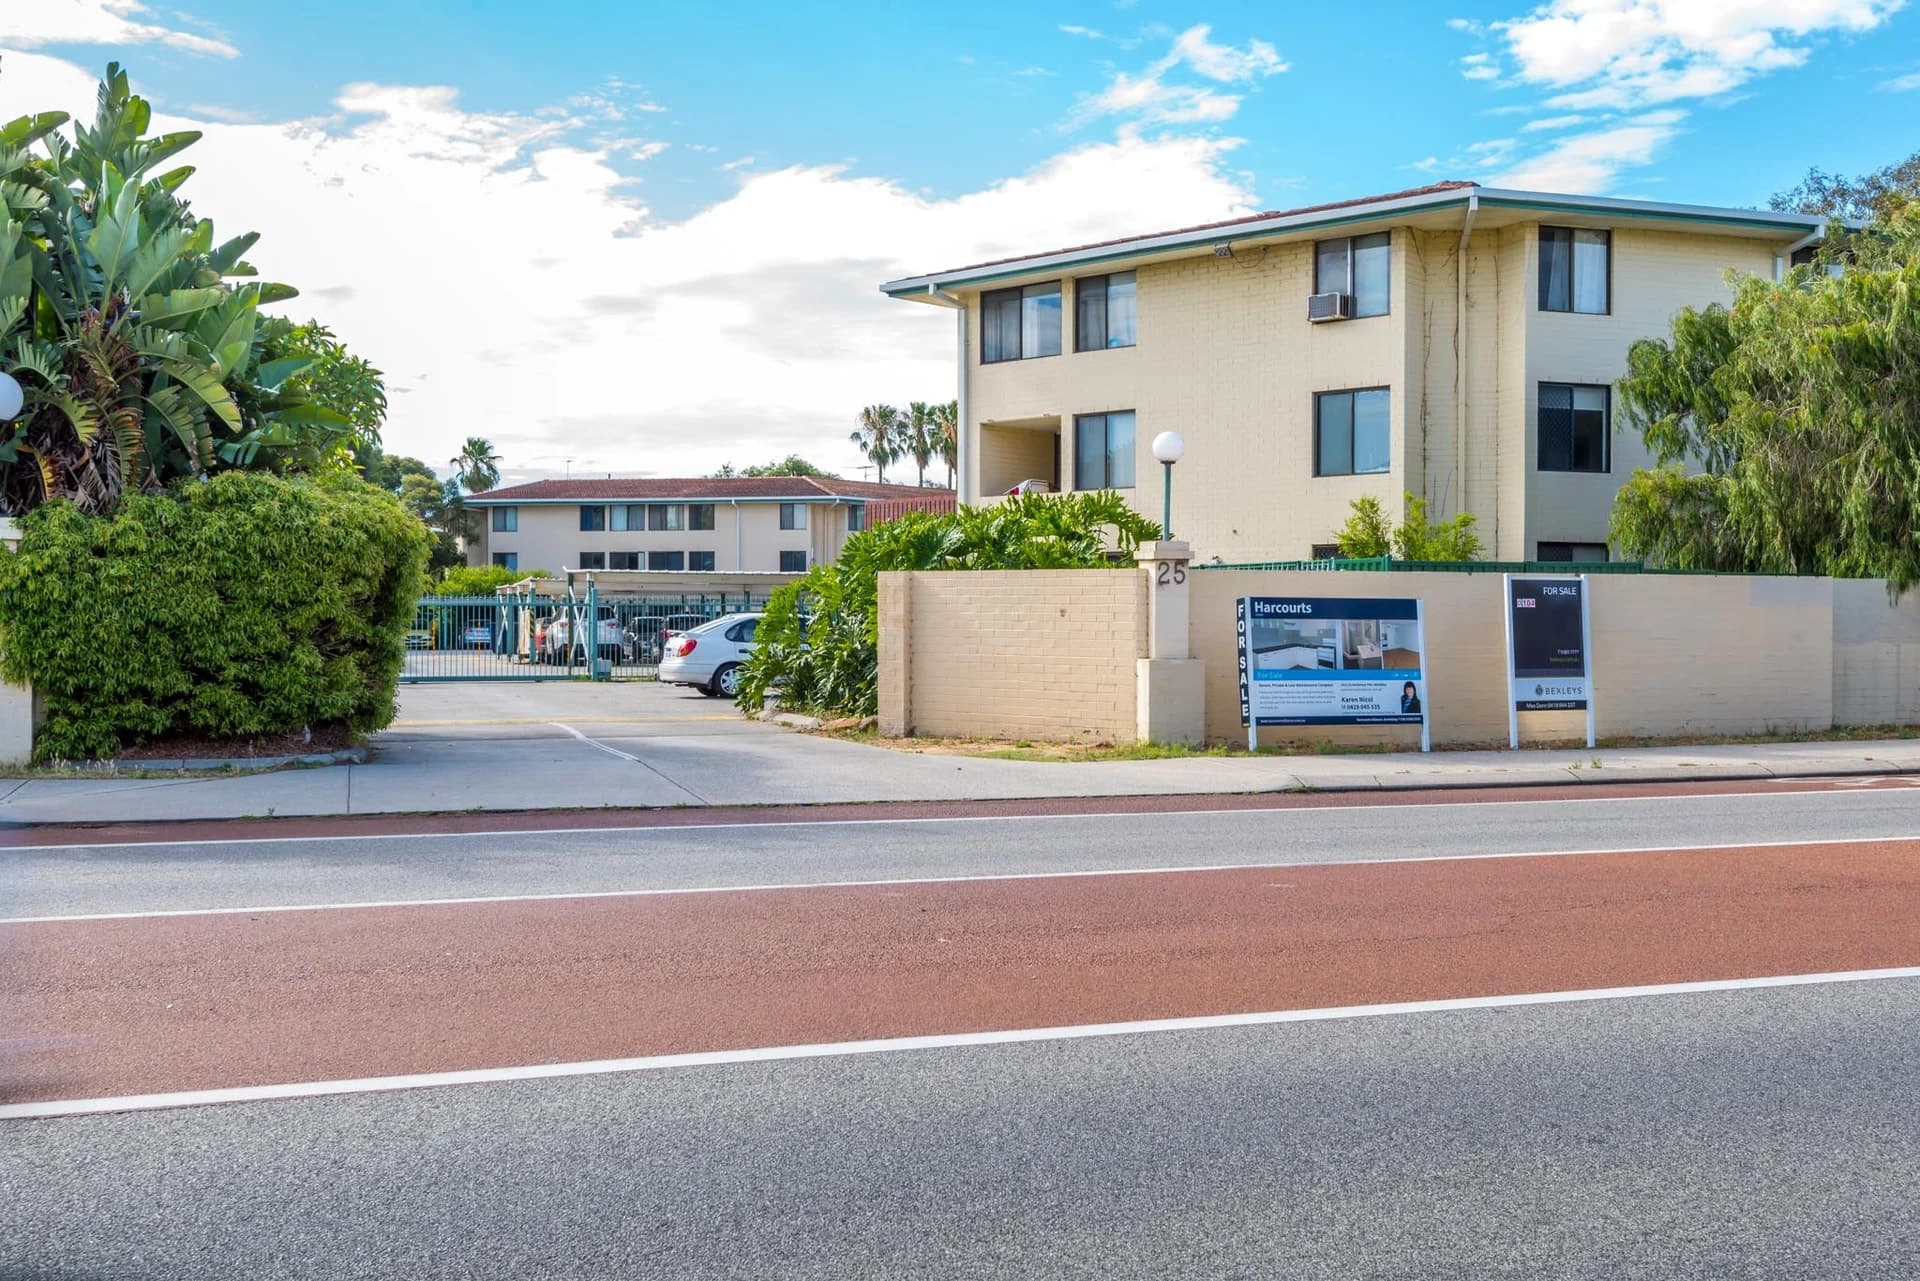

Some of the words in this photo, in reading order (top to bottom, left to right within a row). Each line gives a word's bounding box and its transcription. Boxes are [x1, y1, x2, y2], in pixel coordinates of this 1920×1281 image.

[1158, 561, 1185, 585] 25
[1543, 587, 1557, 595] FOR
[1559, 587, 1576, 595] SALE
[1254, 601, 1312, 614] Harcourts
[1238, 604, 1246, 649] FOR
[1239, 657, 1249, 717] SALE
[1545, 687, 1582, 695] BEXLEYS
